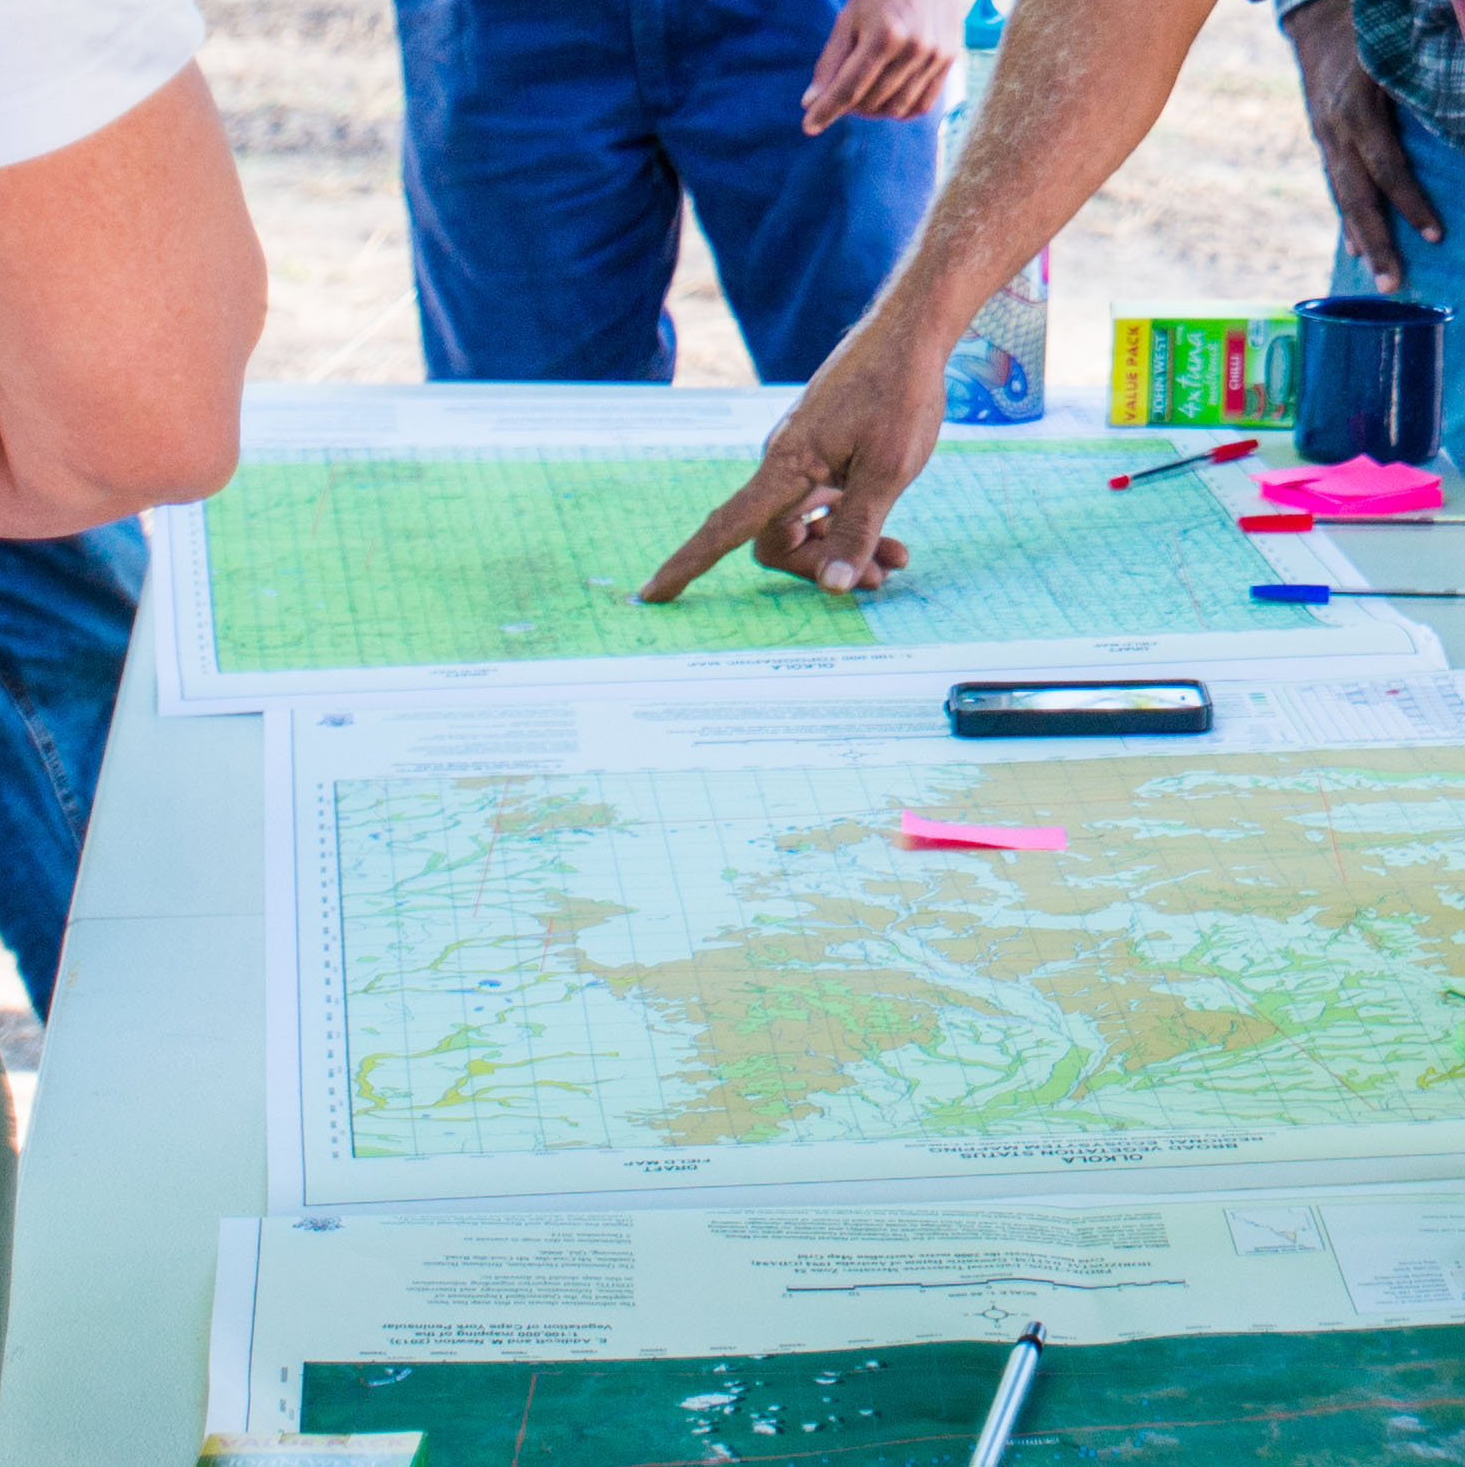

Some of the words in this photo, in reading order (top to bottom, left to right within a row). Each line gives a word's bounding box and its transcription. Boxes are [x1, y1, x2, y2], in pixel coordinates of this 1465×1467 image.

[1126, 325, 1140, 367] PACK
[1152, 335, 1167, 375] WEST
[1229, 354, 1241, 391] CHILLI
[1125, 372, 1139, 422] VALUE
[1152, 377, 1167, 416] JOHN
[928, 1145, 1019, 1153] MAPPING
[1041, 1145, 1162, 1156] VEGETATION
[1168, 1143, 1239, 1151] BROAD
[960, 1151, 1034, 1159] STATUS
[1062, 1153, 1143, 1164] OLKOLA
[642, 1165, 698, 1174] DRAFT
